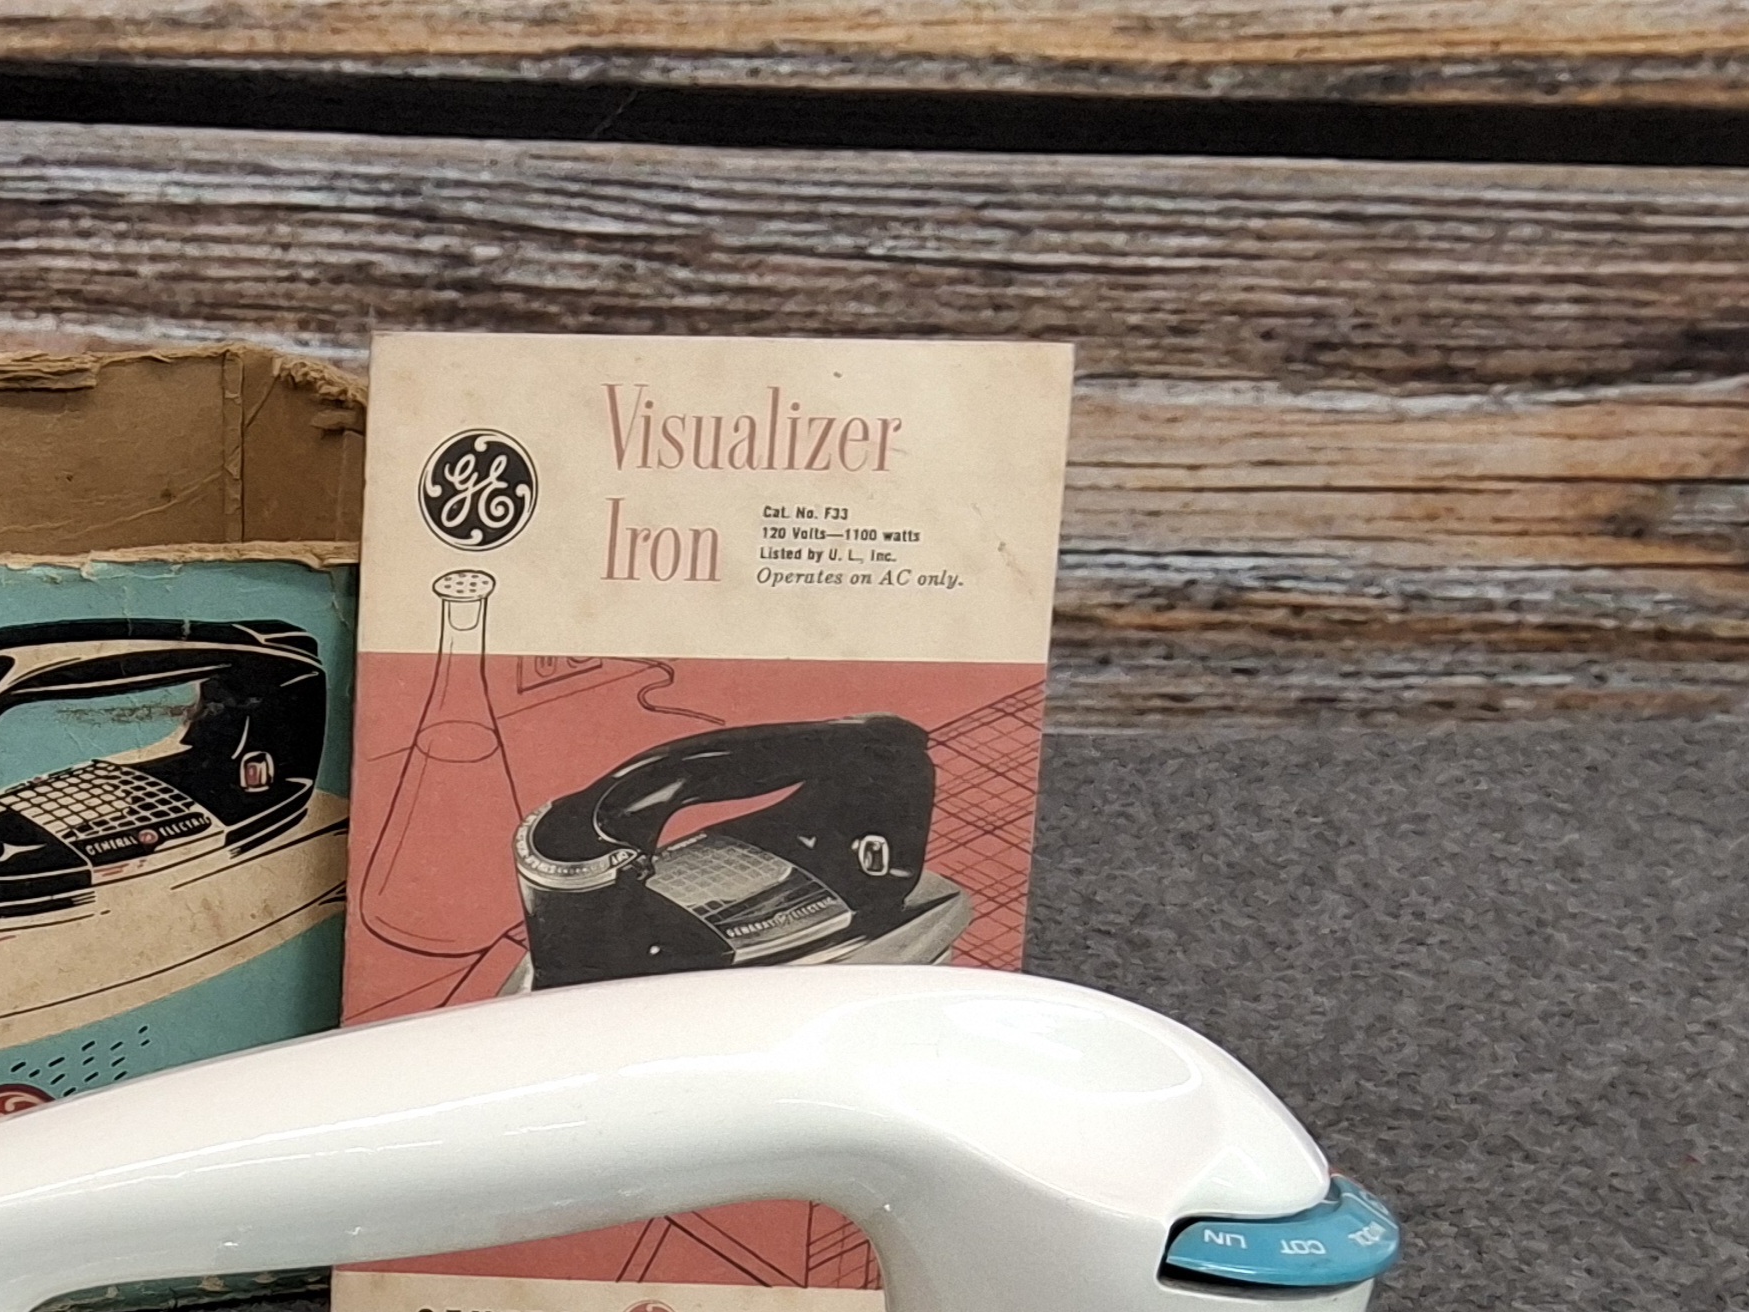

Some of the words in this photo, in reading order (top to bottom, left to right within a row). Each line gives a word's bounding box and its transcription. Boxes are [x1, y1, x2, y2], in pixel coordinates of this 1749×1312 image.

[600, 382, 903, 473] Visualizer
[795, 507, 819, 520] No.
[824, 507, 849, 520] F33
[600, 497, 722, 583] Iron
[762, 527, 786, 540] 120
[882, 529, 921, 542] watts
[759, 547, 802, 561] Listed
[807, 548, 823, 563] by
[828, 548, 843, 562] U.
[870, 550, 897, 562] Inc.
[756, 567, 844, 587] Operates
[850, 573, 872, 586] on
[878, 569, 912, 586] AC
[917, 570, 964, 590] only.
[85, 835, 138, 856] GENERAL
[1203, 1229, 1248, 1249] LIN
[1280, 1239, 1327, 1255] COT
